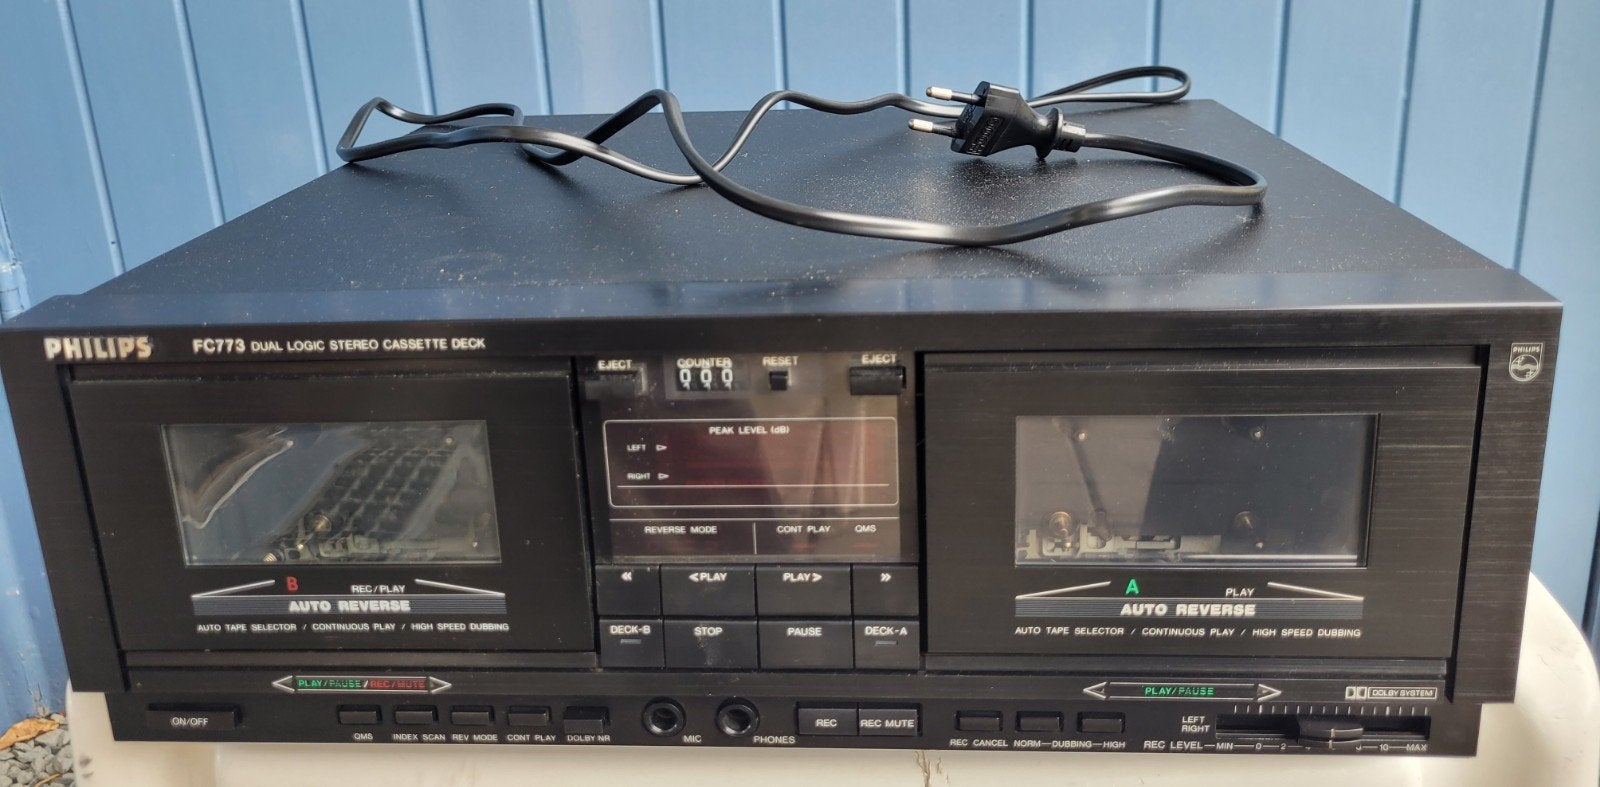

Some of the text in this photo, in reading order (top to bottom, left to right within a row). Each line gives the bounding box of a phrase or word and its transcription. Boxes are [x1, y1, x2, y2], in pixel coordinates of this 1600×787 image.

[44, 336, 152, 360] PHILIPS
[192, 337, 486, 354] FC773 DUAL LOGIC STEREO CASSETTE DECK
[676, 356, 732, 368] COUNTER
[762, 355, 799, 366] RESET
[861, 353, 897, 364] EJECT
[597, 359, 633, 370] EJECT
[709, 425, 790, 435] PEAK LEVEL (dB)
[626, 443, 647, 451] LEFT
[626, 472, 651, 481] RIGHT
[644, 525, 717, 534] REVERSE MODE
[776, 524, 830, 534] CONT PLAY
[854, 523, 877, 533] QMS
[286, 576, 299, 592] B
[351, 584, 406, 594] REC/PLAY
[1125, 578, 1140, 595] A
[1225, 588, 1255, 597] PLAY
[288, 600, 411, 613] AUTO REVERSE
[1120, 603, 1256, 617] AUTO REVERSE
[197, 623, 221, 633] AUTO
[225, 623, 247, 633] TAPE
[251, 623, 298, 632] SELECTOR
[312, 623, 370, 632] CONTINUOUS
[374, 623, 396, 632] PLAY
[411, 622, 434, 632] HIGH
[437, 622, 466, 632] SPEED
[470, 622, 509, 632] DUBBING
[610, 625, 651, 636] DECK-B
[693, 626, 723, 637] STOP
[787, 626, 823, 637] PAUSE
[864, 626, 908, 636] DECK-A
[1015, 626, 1041, 636] AUTO
[1045, 626, 1070, 636] TAPE
[1074, 626, 1124, 636] SELECTOR
[1141, 627, 1206, 637] CONTINUOUS
[1210, 627, 1235, 637] PLAY
[1252, 628, 1277, 637] HIGH
[1281, 628, 1313, 638] SPEED
[1317, 628, 1362, 638] DUBBING
[1144, 686, 1215, 696] PLAY/PAUSE
[1372, 689, 1433, 697] DOLBY SYSTEM
[170, 716, 209, 727] ON/OFF
[816, 718, 837, 728] REC
[860, 719, 914, 729] REC MUTE
[1182, 715, 1205, 724] LEFT
[1181, 724, 1209, 733] RIGHT
[353, 732, 374, 741] QMS
[393, 732, 446, 741] INDEX SCAN
[452, 733, 498, 742] REV MODE
[507, 734, 557, 742] CONT PLAY
[567, 734, 611, 743] DOLBY NR
[683, 734, 702, 743] MIC
[753, 735, 796, 744] PHONES
[950, 738, 1009, 748] REC CANCEL
[1143, 740, 1166, 750] REC
